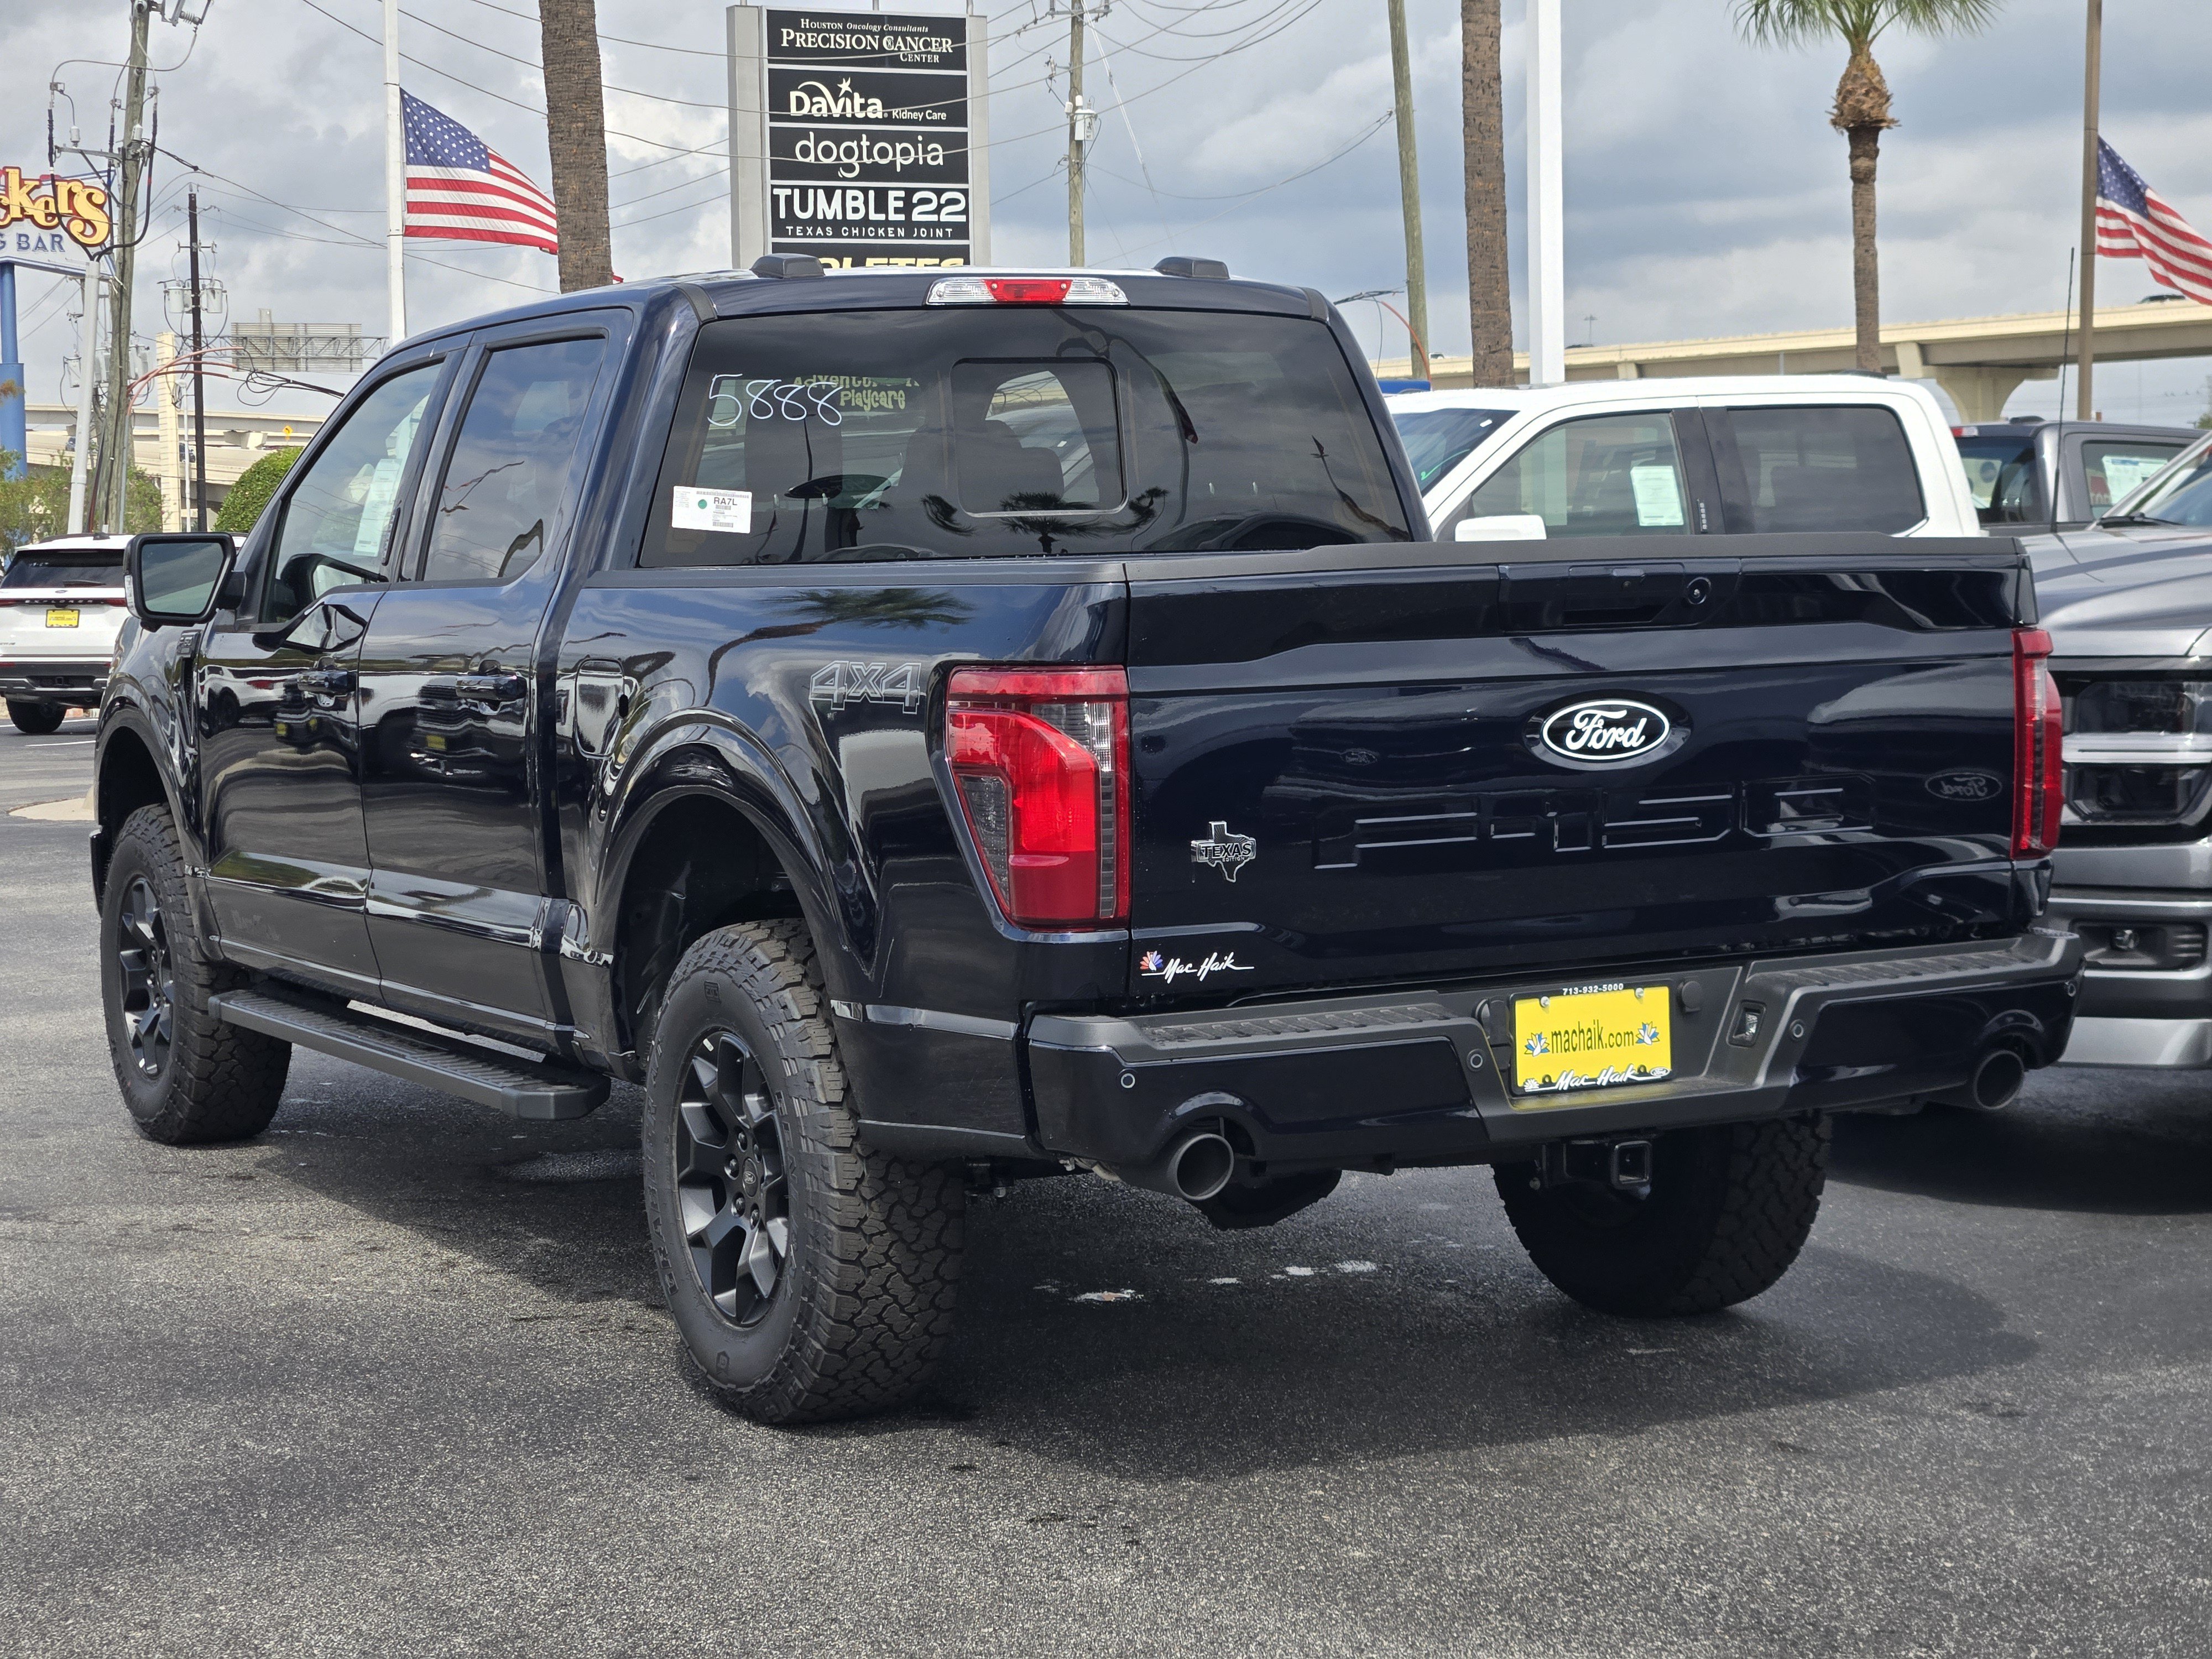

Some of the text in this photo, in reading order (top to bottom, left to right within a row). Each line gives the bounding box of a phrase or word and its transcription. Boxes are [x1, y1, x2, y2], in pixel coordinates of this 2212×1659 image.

[800, 18, 928, 33] HOUSTON Oncology Consultants
[781, 28, 953, 53] PRECISION CANCER
[900, 53, 940, 64] CENTER
[790, 81, 947, 121] DaVita Kidney Care
[795, 132, 943, 178] dogtopia
[773, 189, 967, 222] TUMBLE 22
[17, 232, 65, 252] BAR
[786, 226, 953, 238] TEXAS CHICKEN JOINT
[707, 373, 843, 426] 5888
[839, 389, 906, 413] Playcare
[713, 497, 738, 506] RA7L
[1564, 709, 1645, 751] Ford
[1200, 842, 1252, 858] TEXAS
[1562, 983, 1624, 996] 713-932-5000
[1551, 1019, 1635, 1054] machaik.com
